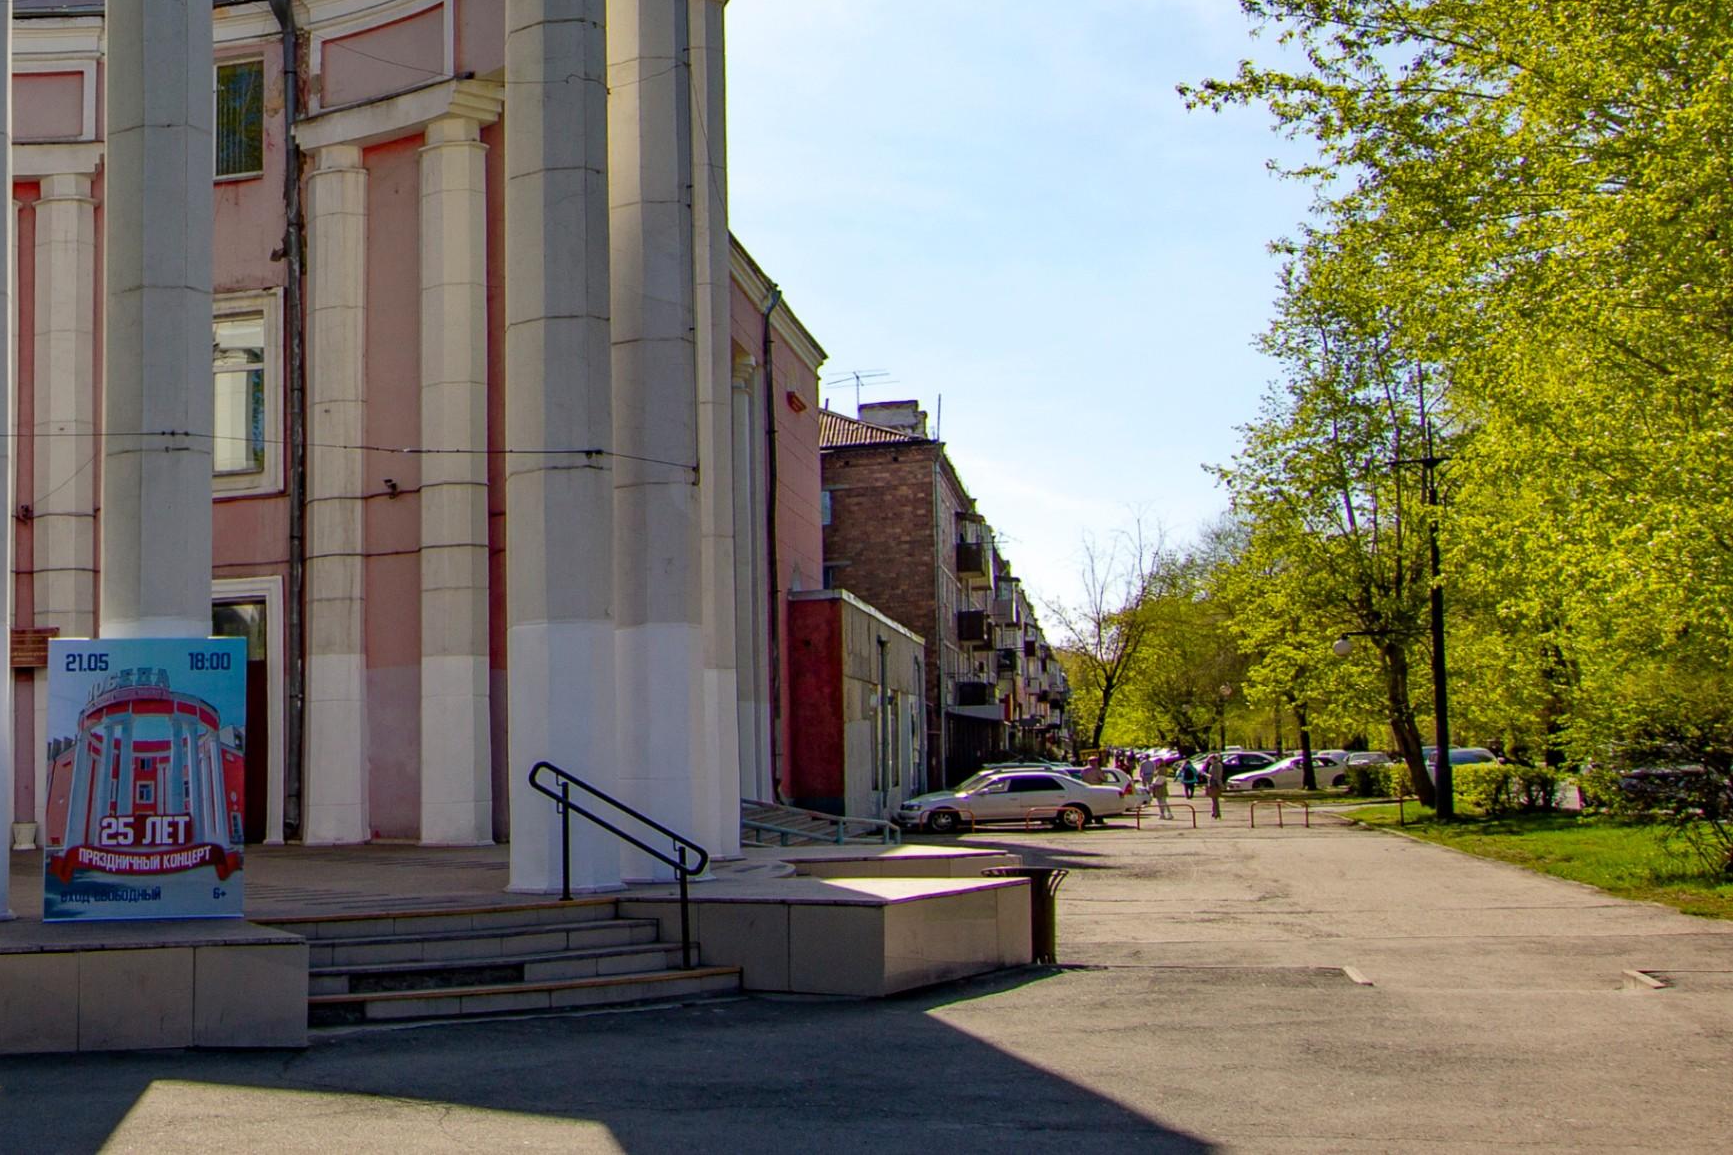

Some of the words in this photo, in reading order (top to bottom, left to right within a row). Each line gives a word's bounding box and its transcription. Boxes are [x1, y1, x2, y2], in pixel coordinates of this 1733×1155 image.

[65, 653, 110, 672] 21.05
[188, 652, 231, 671] 18:00
[101, 817, 134, 845] 25
[142, 815, 190, 845] ЛЕТ
[78, 847, 161, 872] ПРАЗДНИЧНЫЙ
[163, 845, 212, 870] КОНЦЕРТ
[213, 887, 227, 899] 6+
